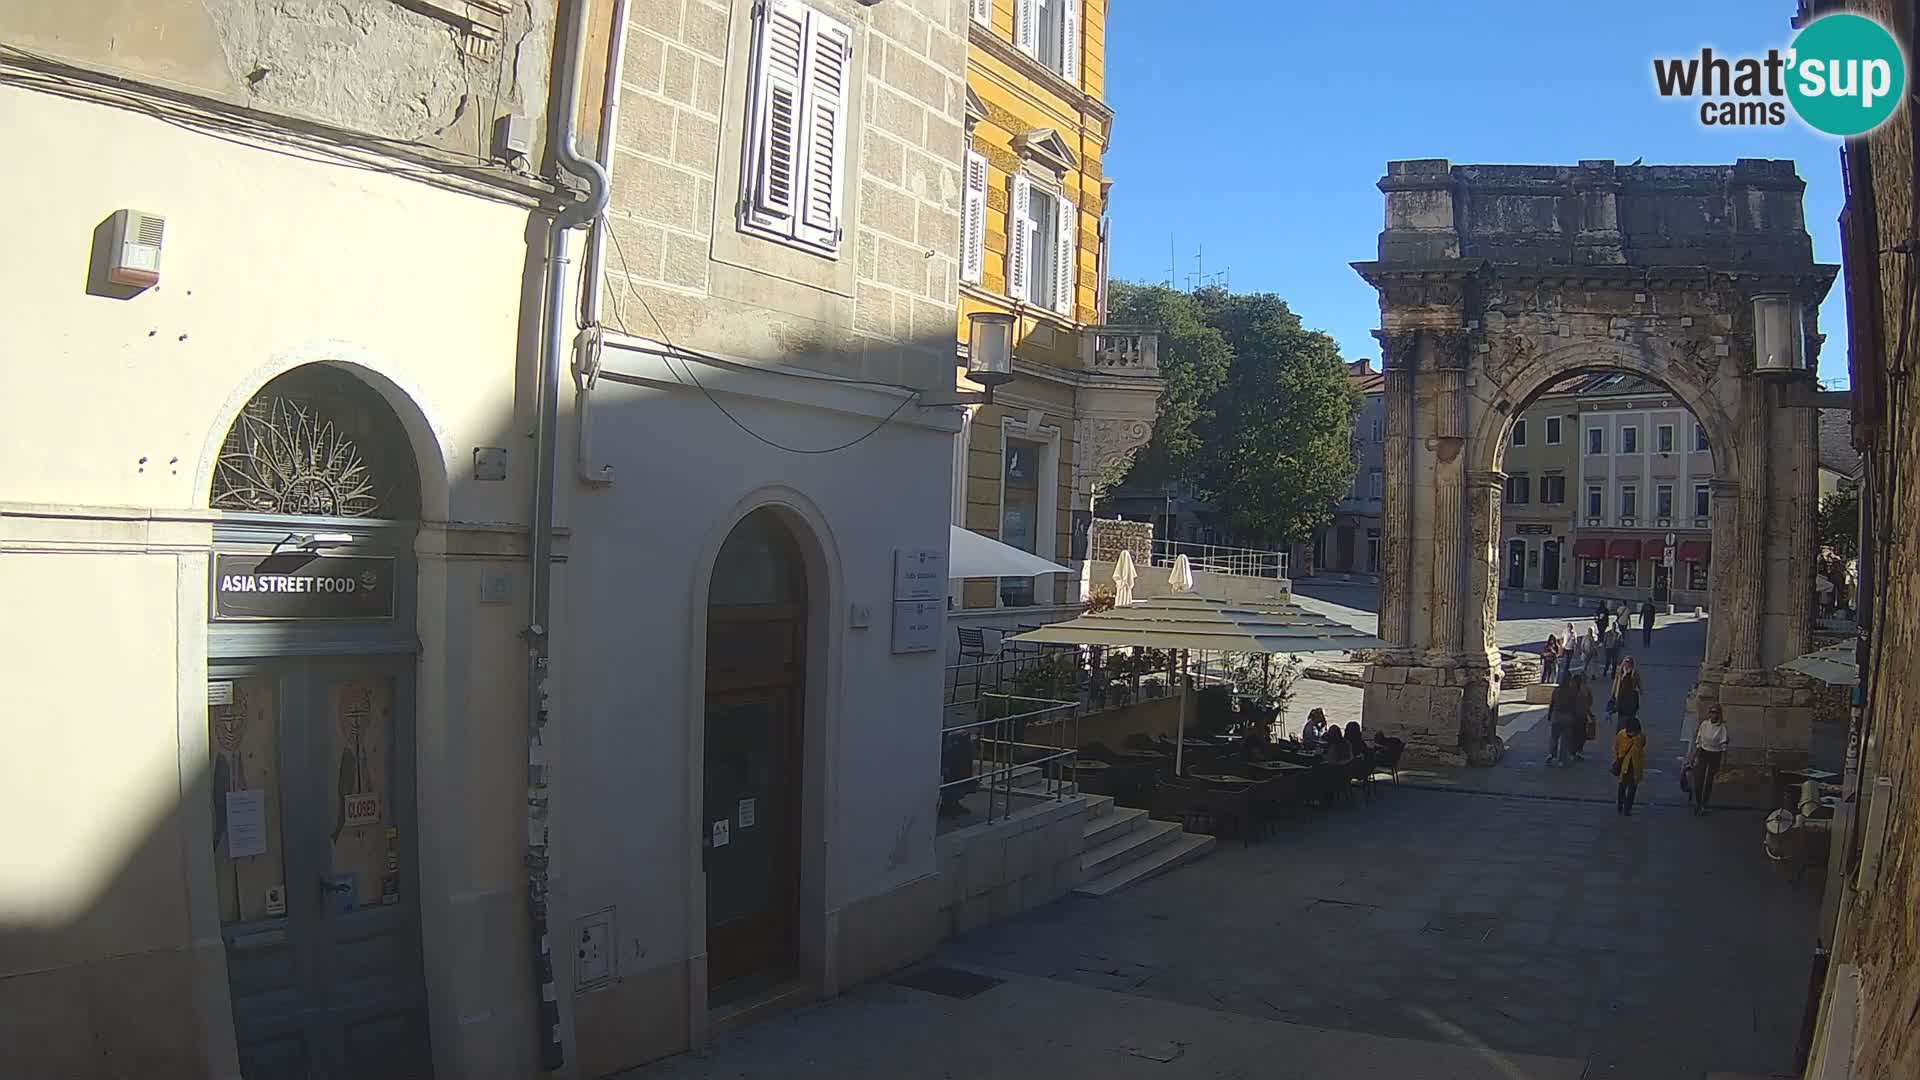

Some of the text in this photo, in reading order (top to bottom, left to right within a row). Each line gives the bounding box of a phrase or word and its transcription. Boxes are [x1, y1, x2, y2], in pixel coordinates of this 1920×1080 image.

[221, 575, 355, 593] ASIA STREET FOOD
[348, 800, 376, 818] CLOSED
